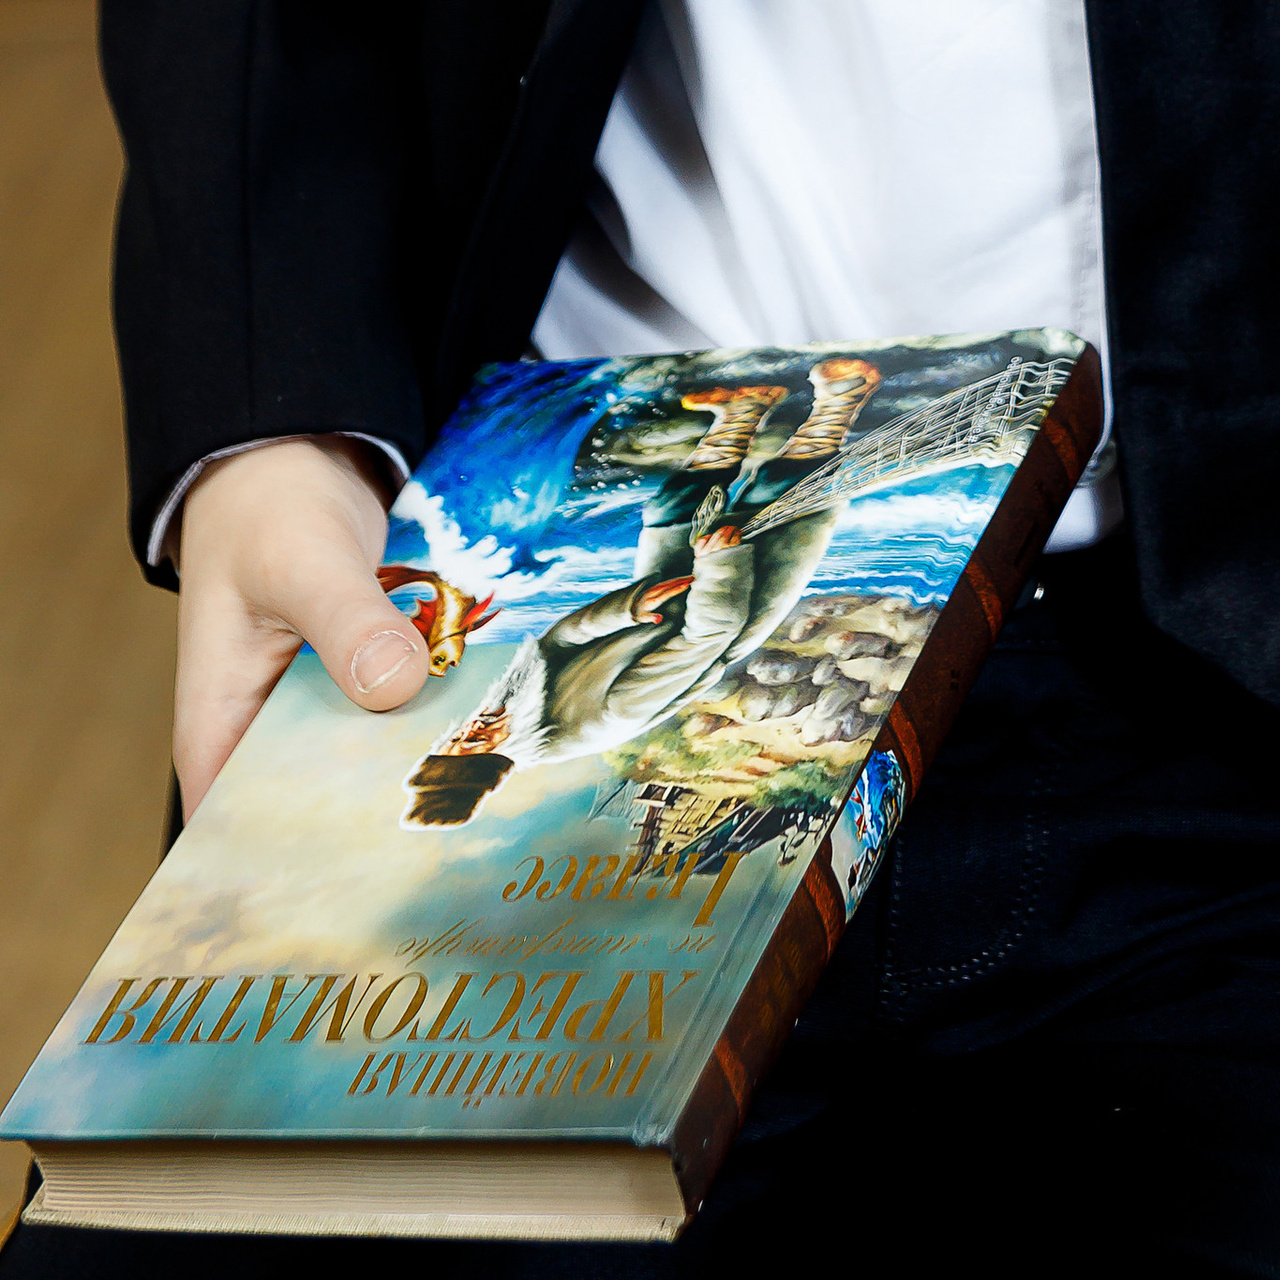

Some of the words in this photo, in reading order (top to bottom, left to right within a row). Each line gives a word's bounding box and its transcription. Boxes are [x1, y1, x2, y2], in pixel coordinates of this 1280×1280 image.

[502, 852, 705, 902] класс
[692, 851, 752, 928] 1
[79, 970, 700, 1045] ХРЕСТОМАТИЯ
[347, 1051, 654, 1110] НОВЕЙШАЯ
